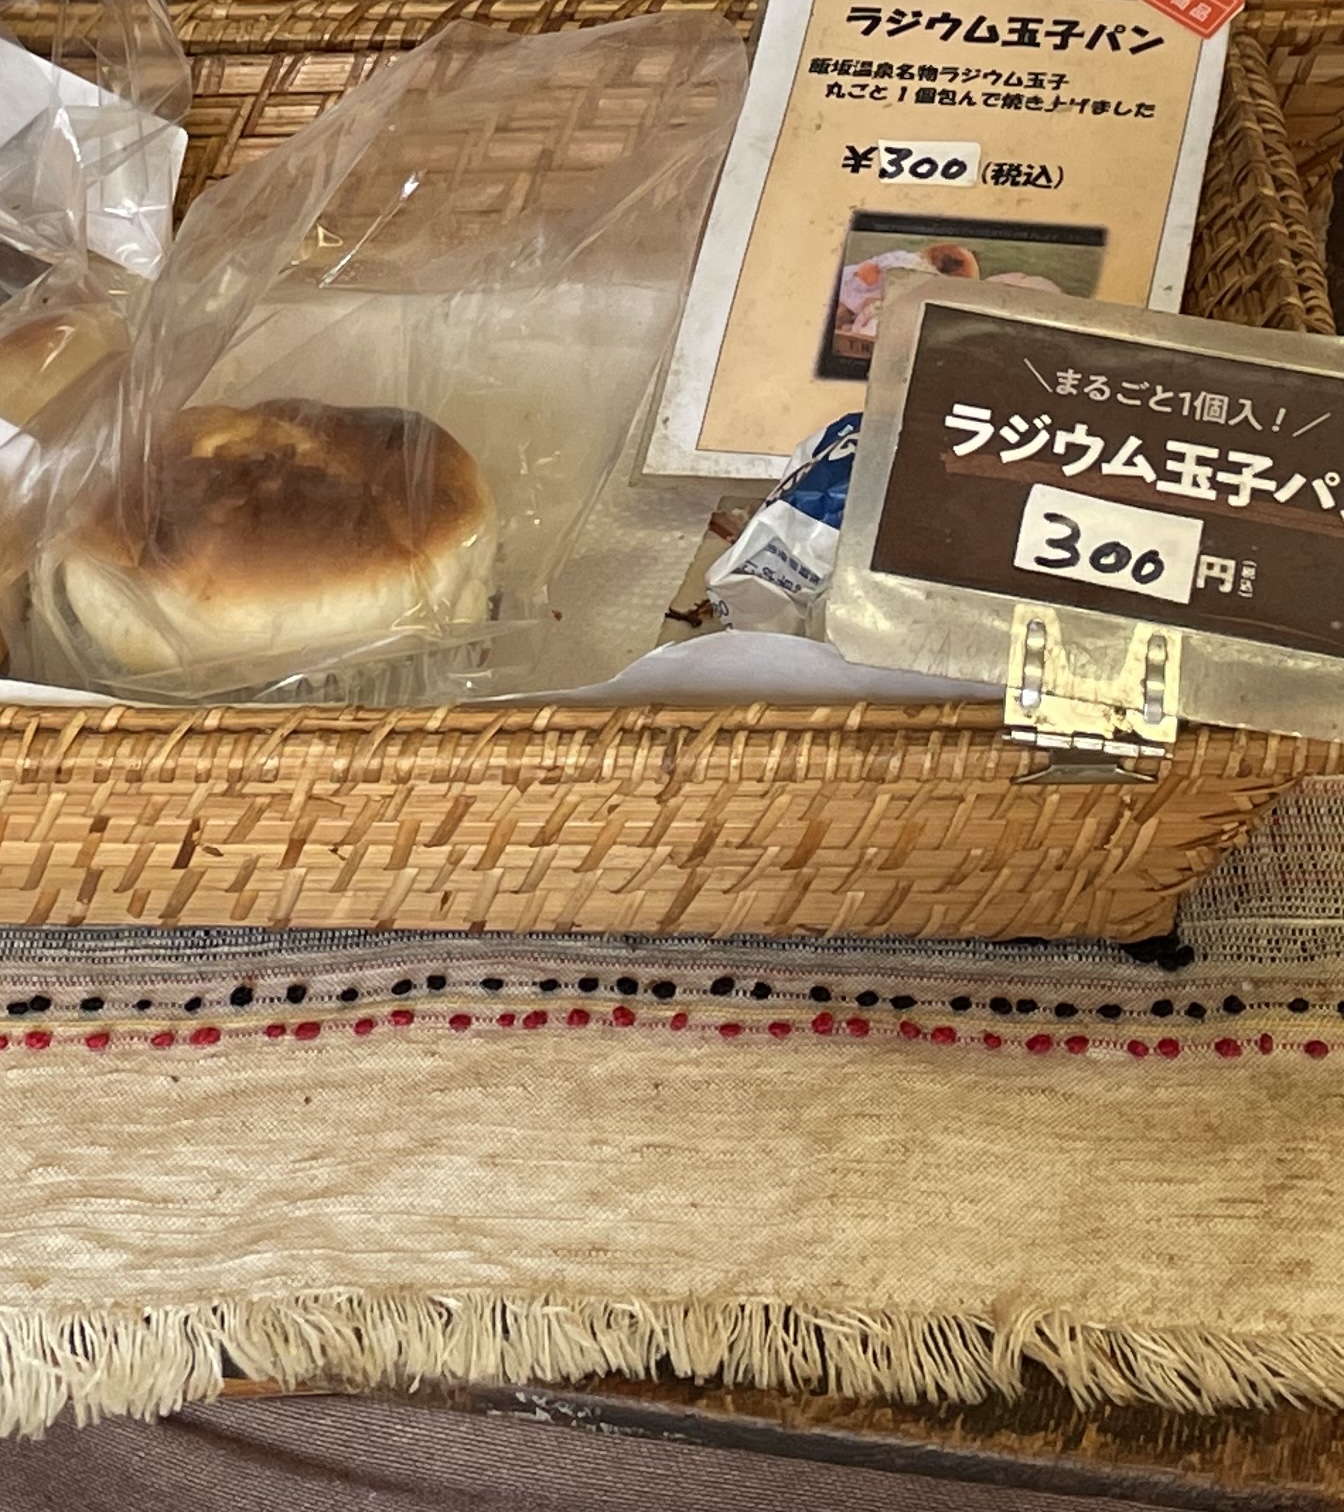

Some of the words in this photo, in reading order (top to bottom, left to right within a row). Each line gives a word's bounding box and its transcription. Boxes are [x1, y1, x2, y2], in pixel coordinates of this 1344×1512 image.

[846, 4, 1166, 57] ラジウム玉子パン
[808, 56, 1071, 92] 飯坂温泉名物ラジウム玉子
[825, 80, 1157, 120] 丸ごと1個包んで焼き上げました
